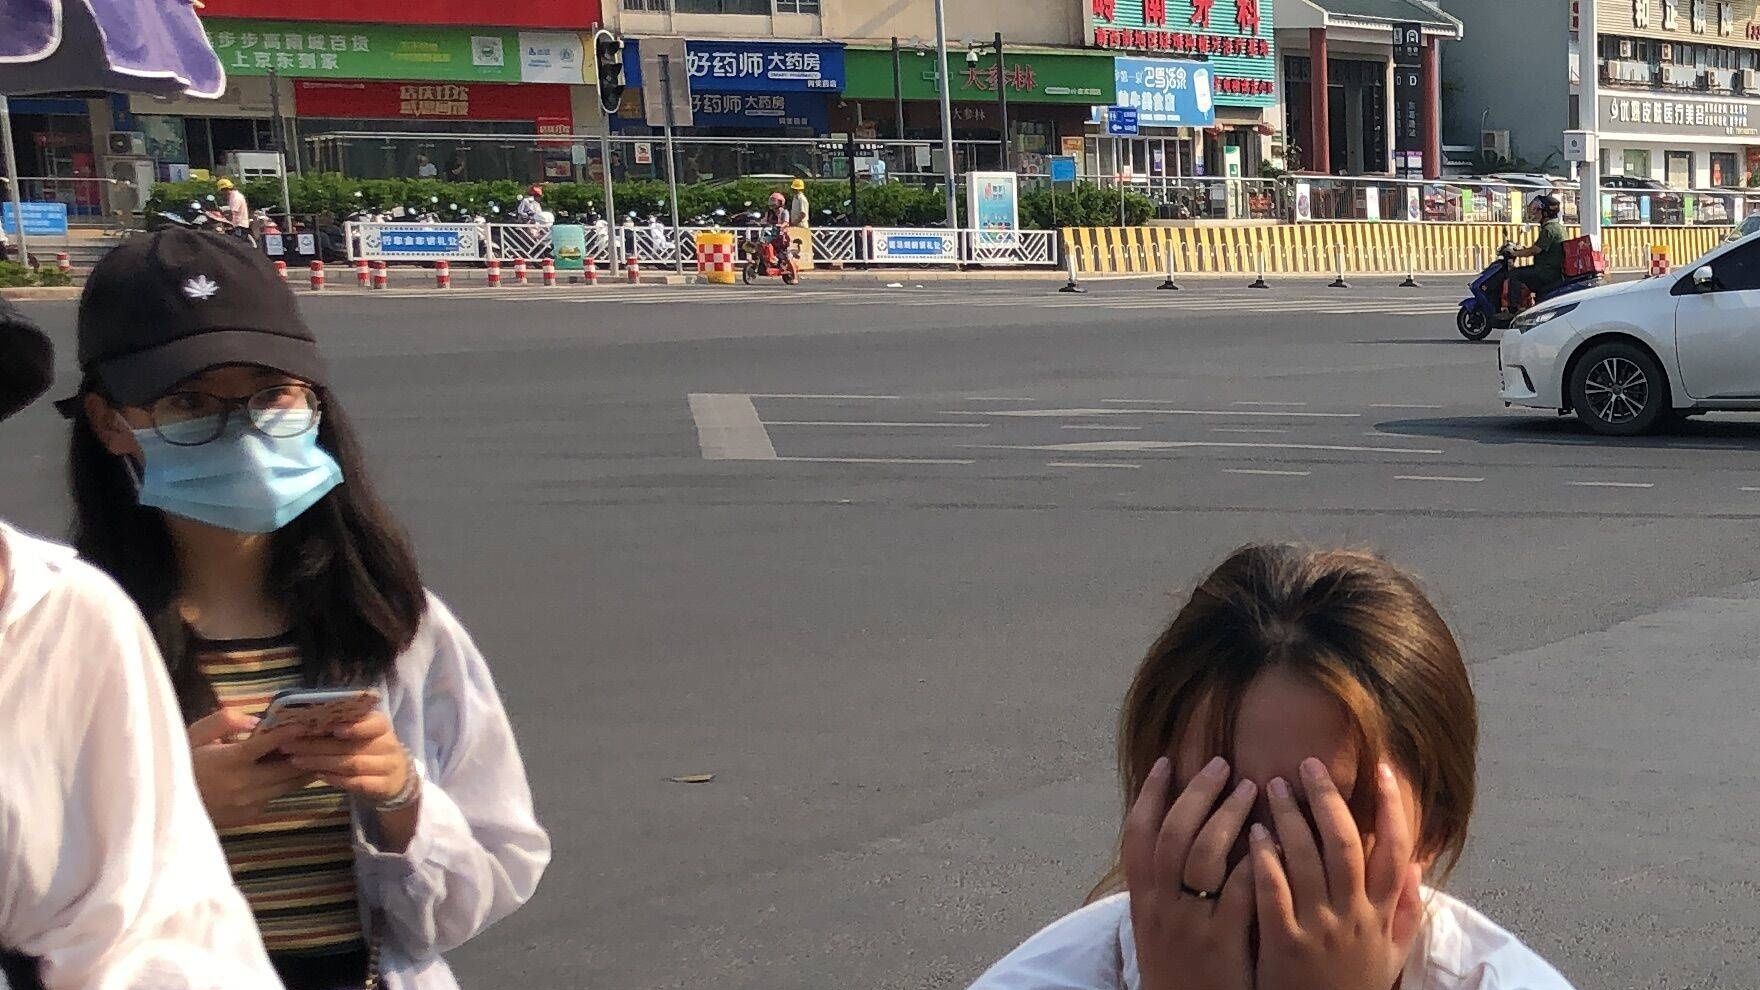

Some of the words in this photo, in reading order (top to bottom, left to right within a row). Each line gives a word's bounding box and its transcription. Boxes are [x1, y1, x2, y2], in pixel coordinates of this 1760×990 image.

[687, 51, 764, 78] 好药师
[767, 52, 821, 70] 大药房
[959, 63, 1038, 92] 大参林
